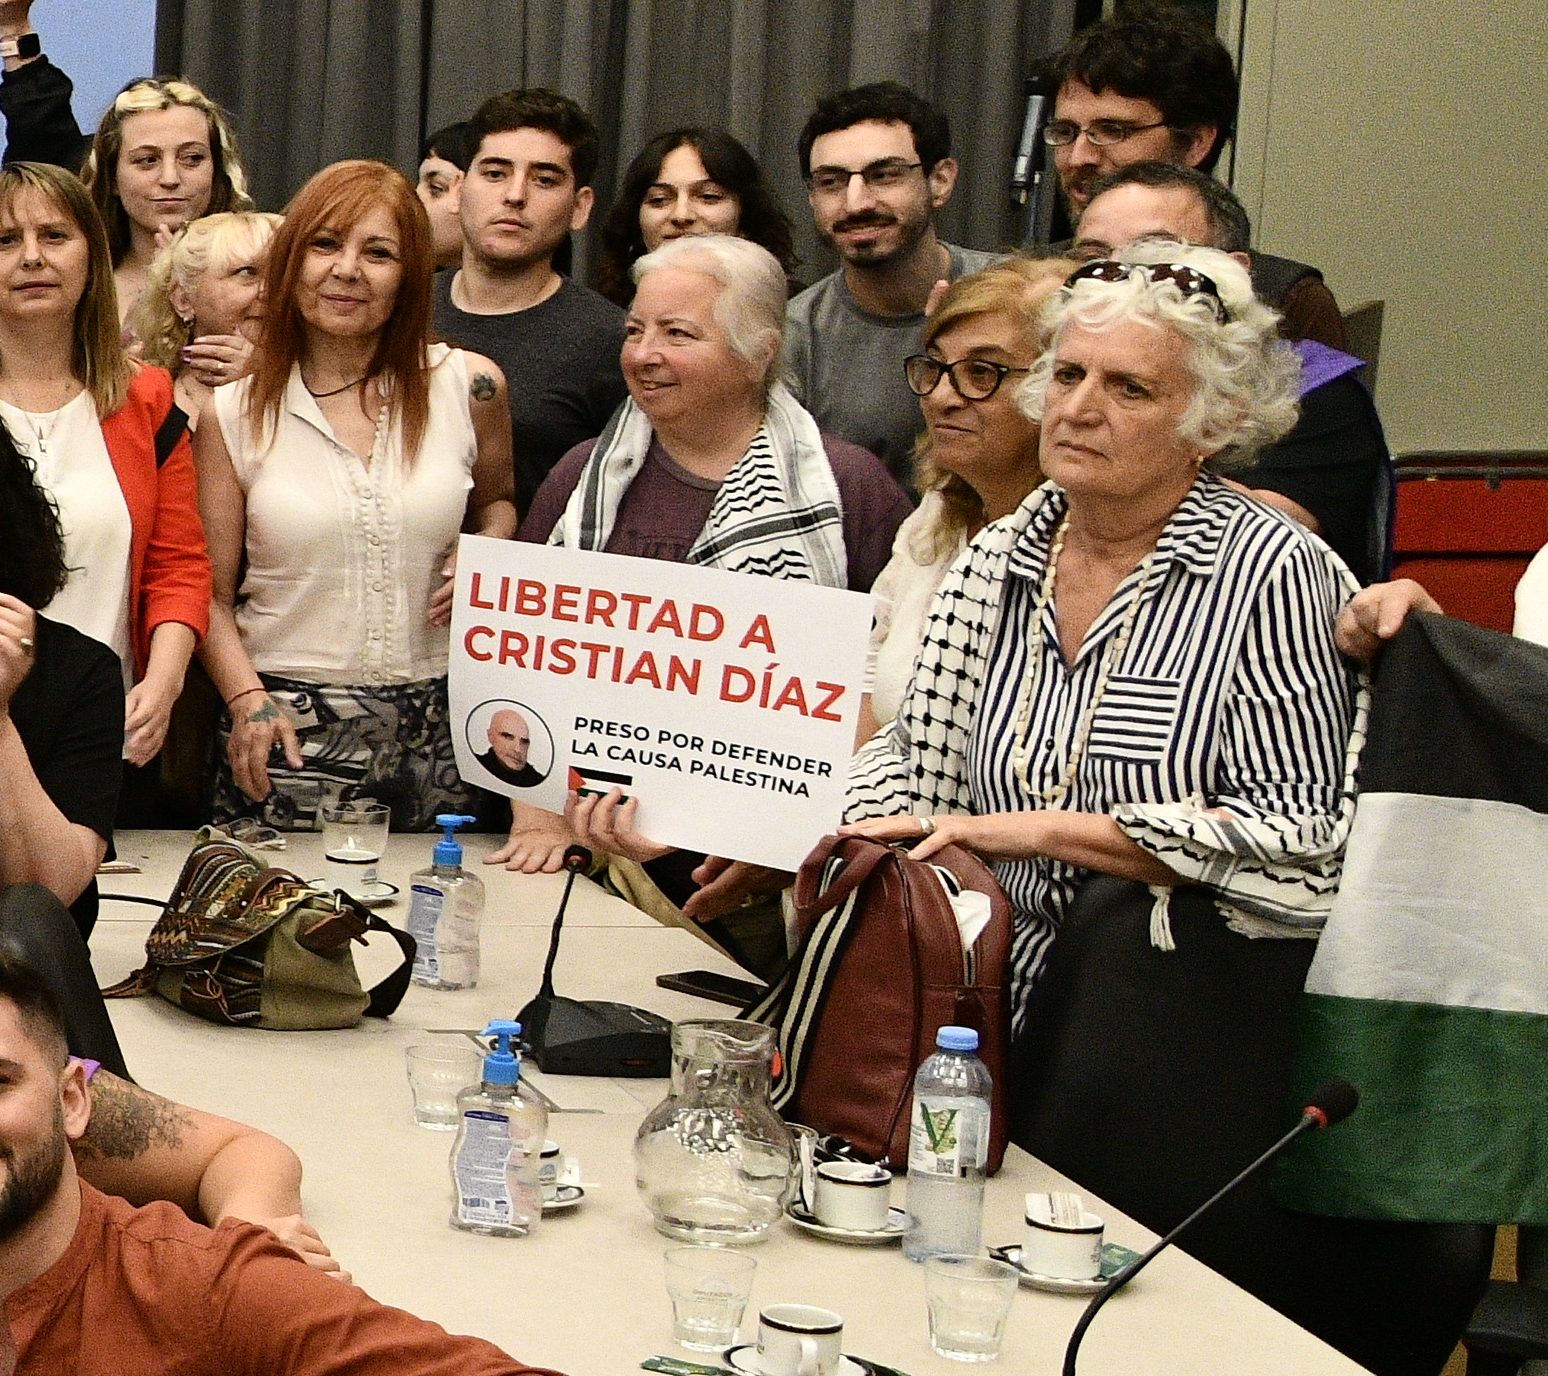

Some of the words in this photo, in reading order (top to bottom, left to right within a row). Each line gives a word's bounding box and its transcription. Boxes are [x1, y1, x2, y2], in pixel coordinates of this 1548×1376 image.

[468, 572, 725, 642] LIBERTAD
[738, 614, 777, 654] A
[463, 625, 702, 695] CRISTIAN
[720, 662, 847, 722] DÍAZ
[572, 739, 599, 757] LA
[606, 746, 682, 772] CAUSA
[689, 760, 810, 798] PALESTINA
[574, 716, 650, 742] PRESO
[657, 730, 705, 752] POR
[711, 741, 832, 778] DEFENDER
